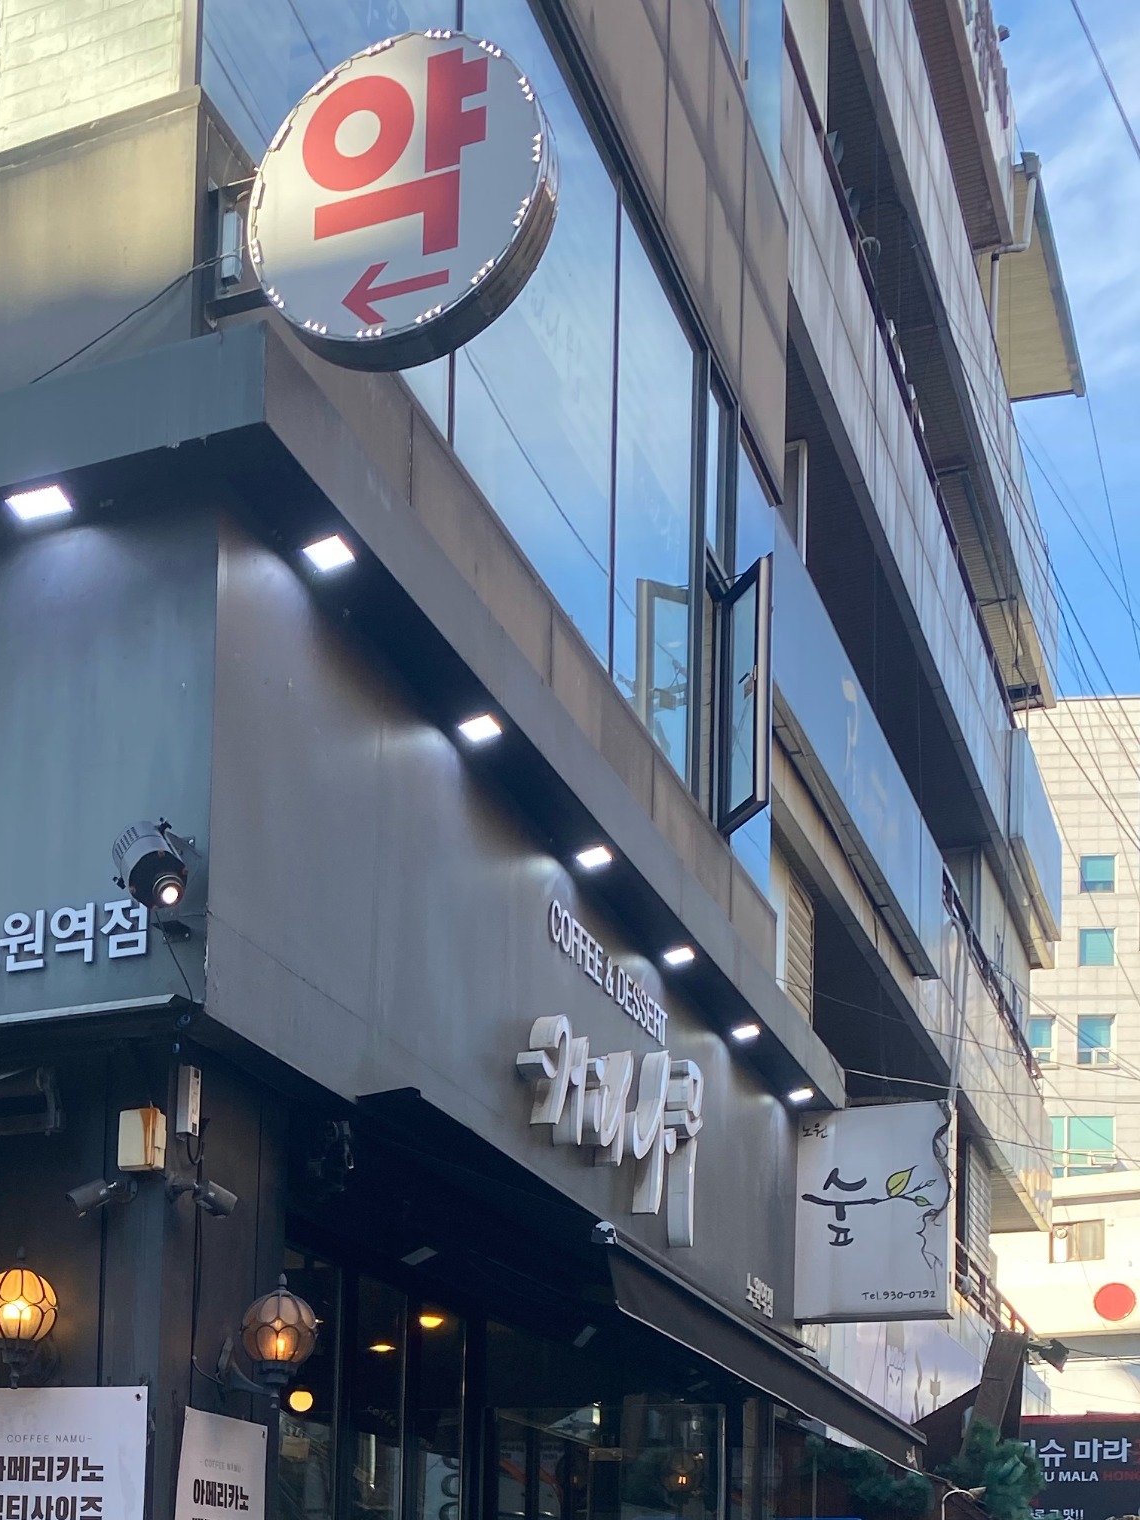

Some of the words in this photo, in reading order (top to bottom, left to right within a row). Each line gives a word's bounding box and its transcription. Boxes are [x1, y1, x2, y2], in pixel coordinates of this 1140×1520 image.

[302, 48, 488, 256] 약
[550, 900, 604, 986] COFFEE
[605, 956, 614, 997] &
[615, 965, 668, 1046] DESSERT
[516, 1014, 703, 1248] 커피나무
[802, 1123, 828, 1138] 노원
[7, 1434, 50, 1443] COFFEE
[55, 1434, 86, 1443] NAMU
[1020, 1439, 1067, 1467] 슈
[1074, 1438, 1132, 1462] 마라
[1058, 1471, 1099, 1482] MALA
[193, 1478, 249, 1511] 아메리카노
[1063, 1509, 1084, 1520] 맛!!
